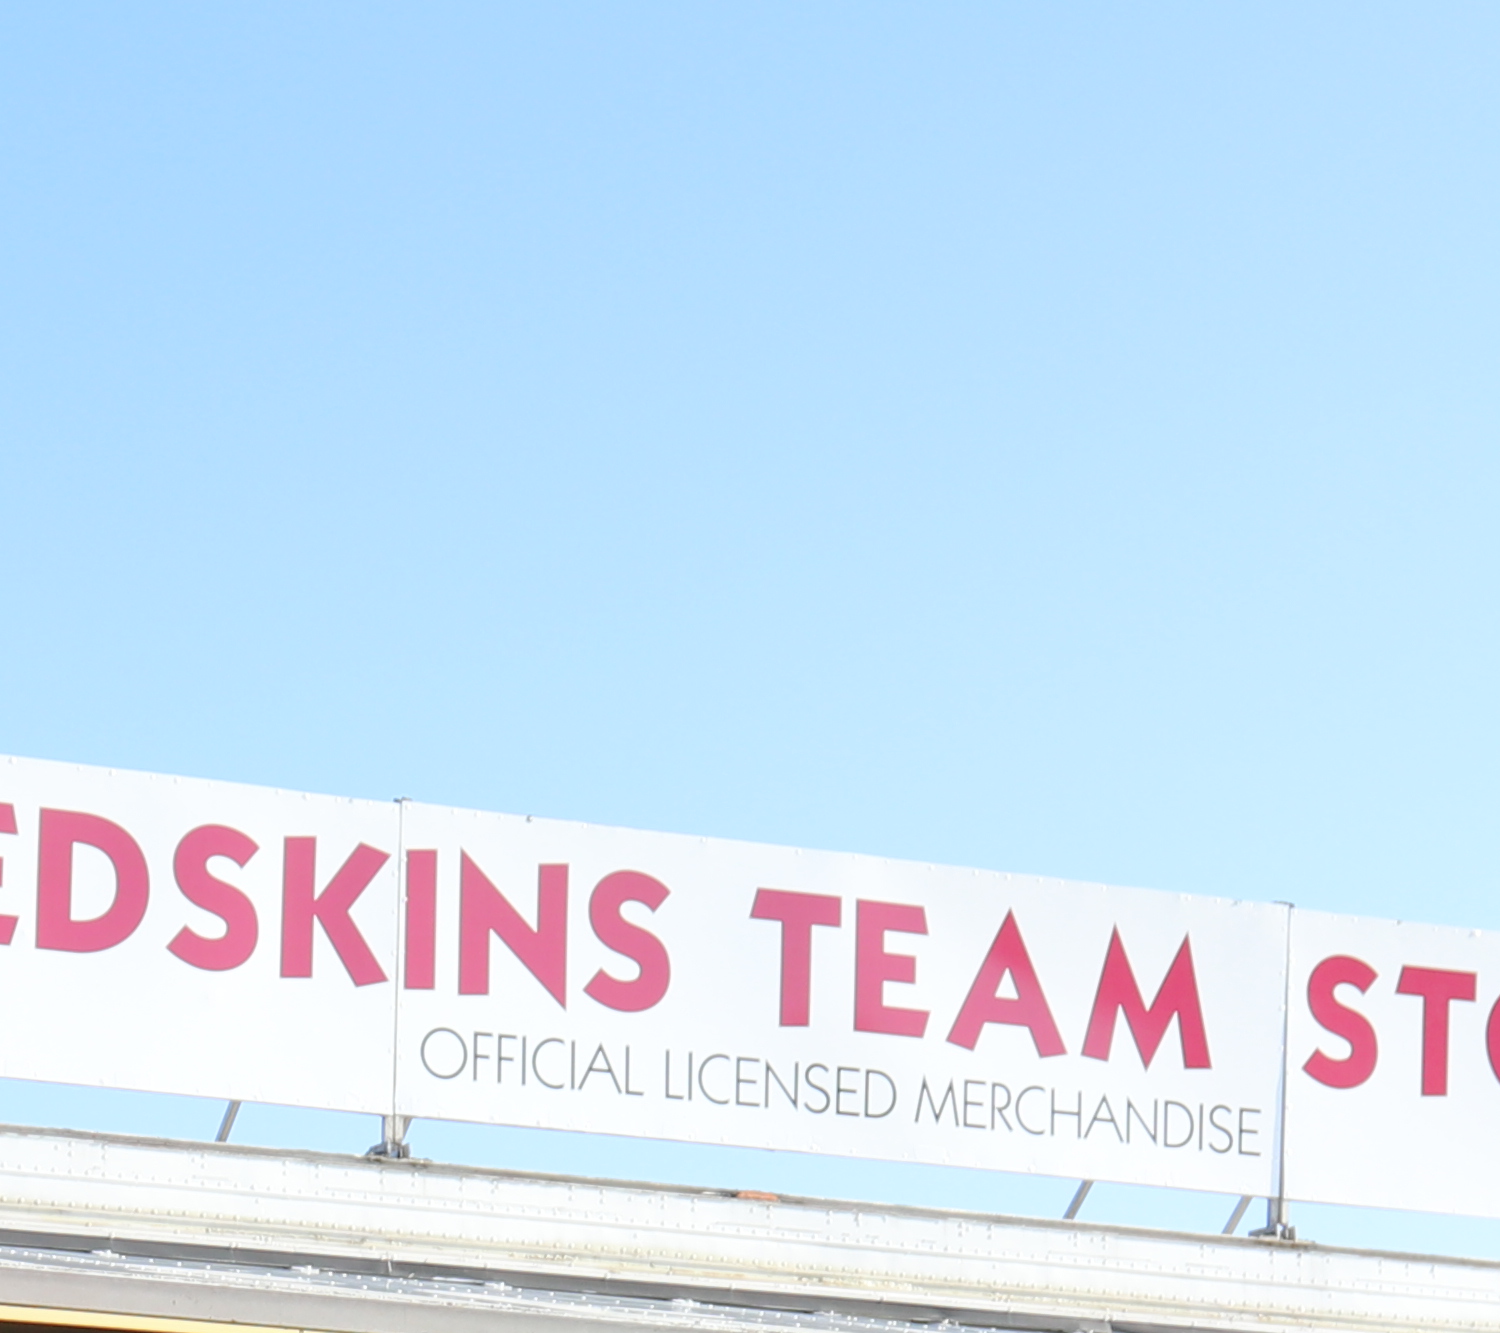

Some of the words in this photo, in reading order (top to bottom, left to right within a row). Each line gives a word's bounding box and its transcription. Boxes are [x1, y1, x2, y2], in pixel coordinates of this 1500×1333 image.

[749, 887, 1213, 1071] TEAM
[419, 1026, 645, 1098] OFFICIAL
[663, 1049, 898, 1120] LICENSED
[913, 1076, 1264, 1157] MERCHANDISE
